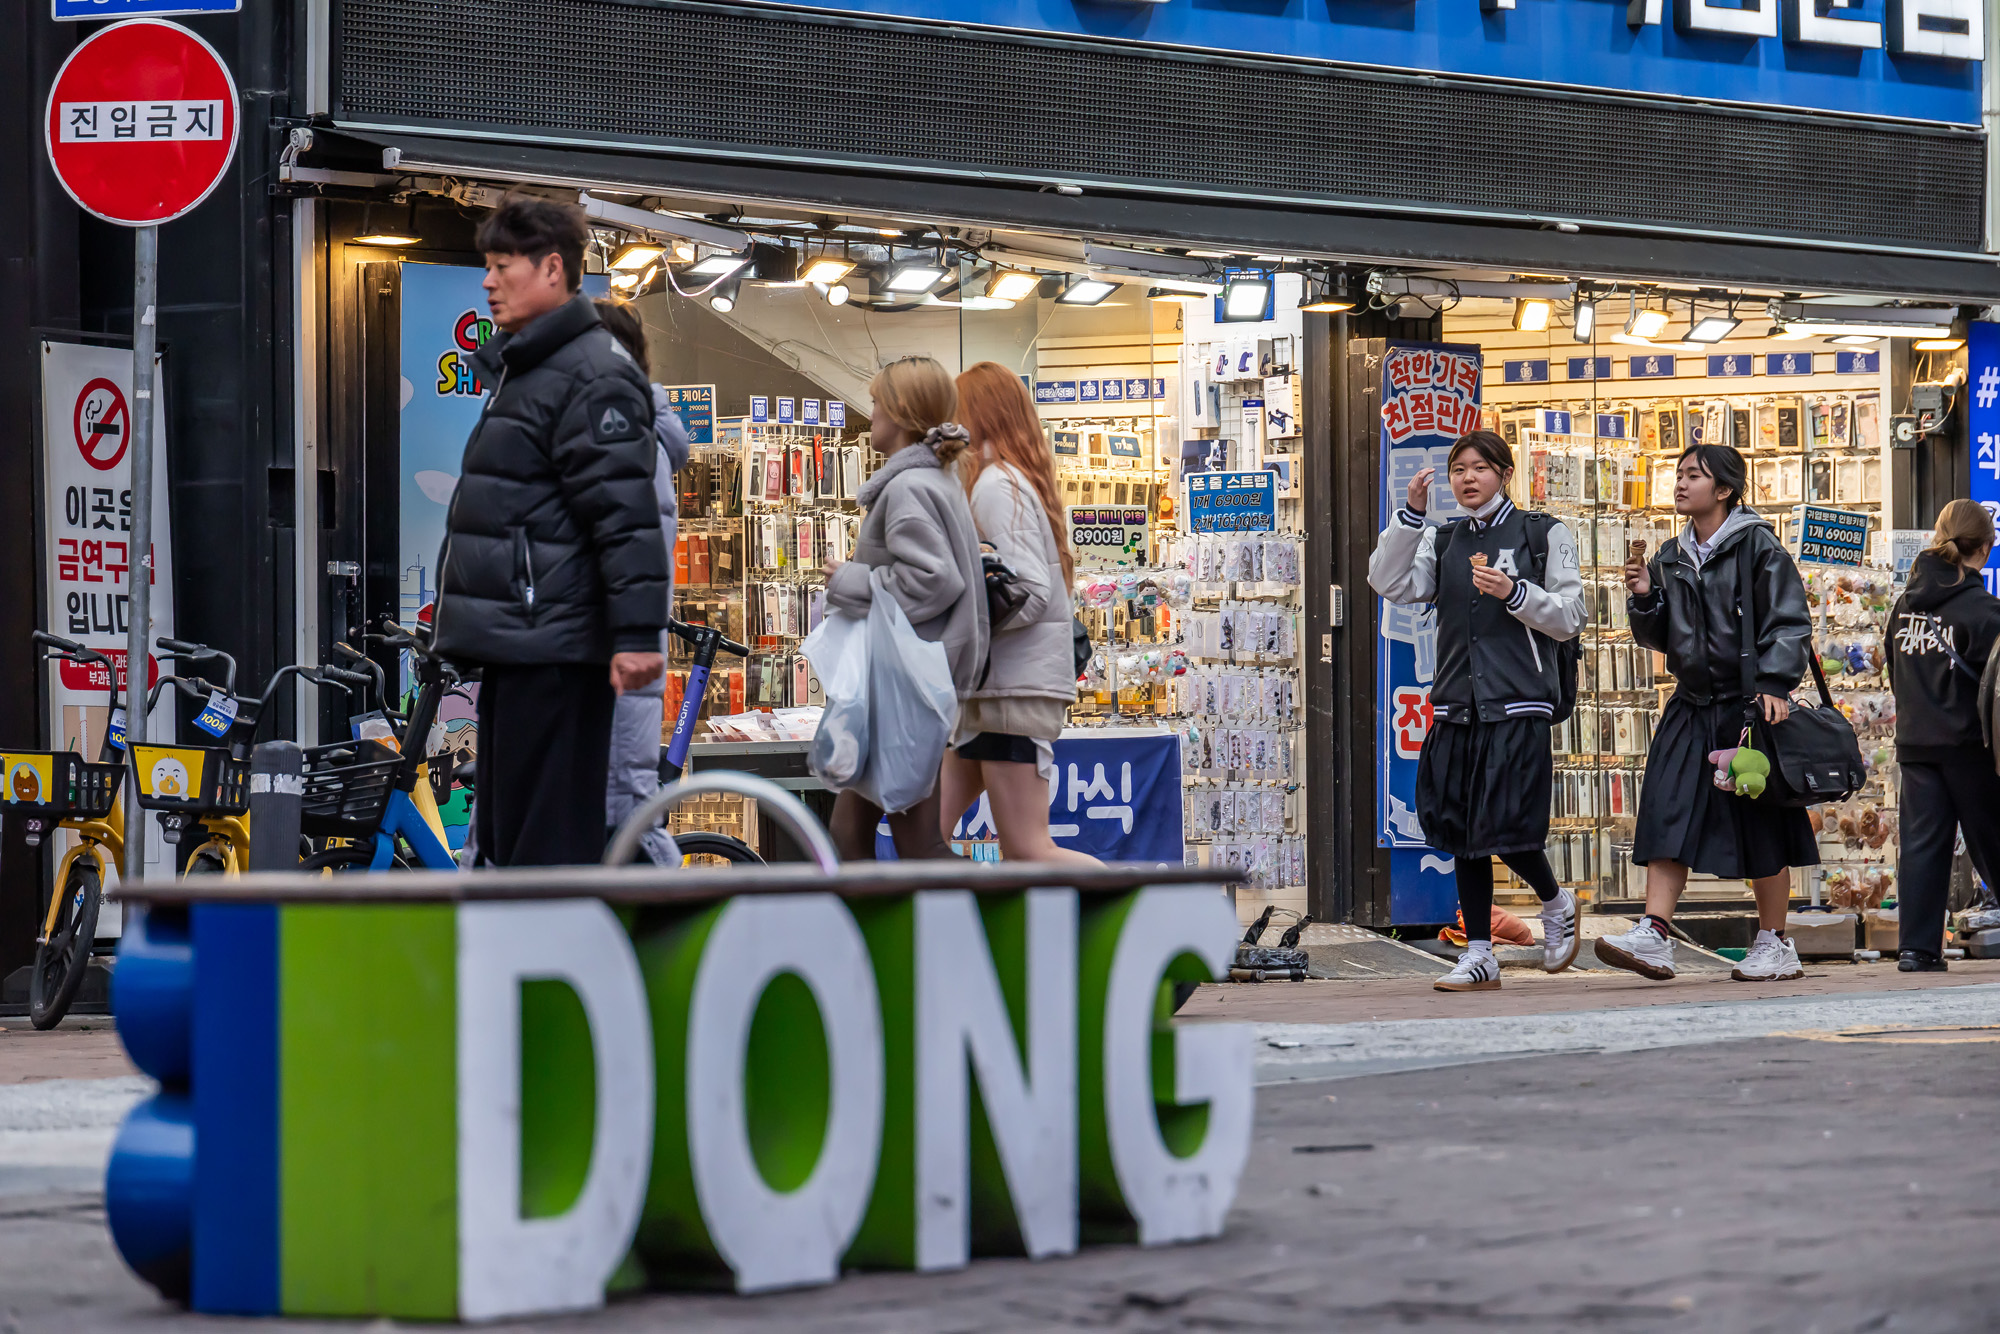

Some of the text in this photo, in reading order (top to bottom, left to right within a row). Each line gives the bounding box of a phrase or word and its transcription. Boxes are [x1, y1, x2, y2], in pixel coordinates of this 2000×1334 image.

[70, 104, 214, 138] 진입금지
[454, 310, 502, 352] CR
[1389, 353, 1479, 398] 착한 가격
[682, 390, 711, 402] 케이스
[1037, 388, 1075, 398] SE2/SE3
[1082, 385, 1096, 397] XS
[1104, 385, 1120, 396] XR
[755, 404, 766, 416] N8
[781, 405, 792, 417] N9
[805, 407, 818, 419] N10
[830, 408, 844, 420] N10
[1192, 477, 1205, 491] 폰
[1227, 474, 1268, 489] 스트랩
[1193, 492, 1263, 509] 1개 6900원
[1099, 511, 1121, 524] 미니
[1124, 511, 1146, 524] 인형
[1075, 529, 1123, 544] 8900원
[1808, 525, 1862, 544] 1개 6900원
[1802, 542, 1862, 562] 2개 10000원
[58, 538, 155, 585] 금연구
[1492, 548, 1519, 577] A
[201, 713, 228, 731] 100원
[674, 699, 691, 734] beam
[458, 884, 1255, 1322] DONG
